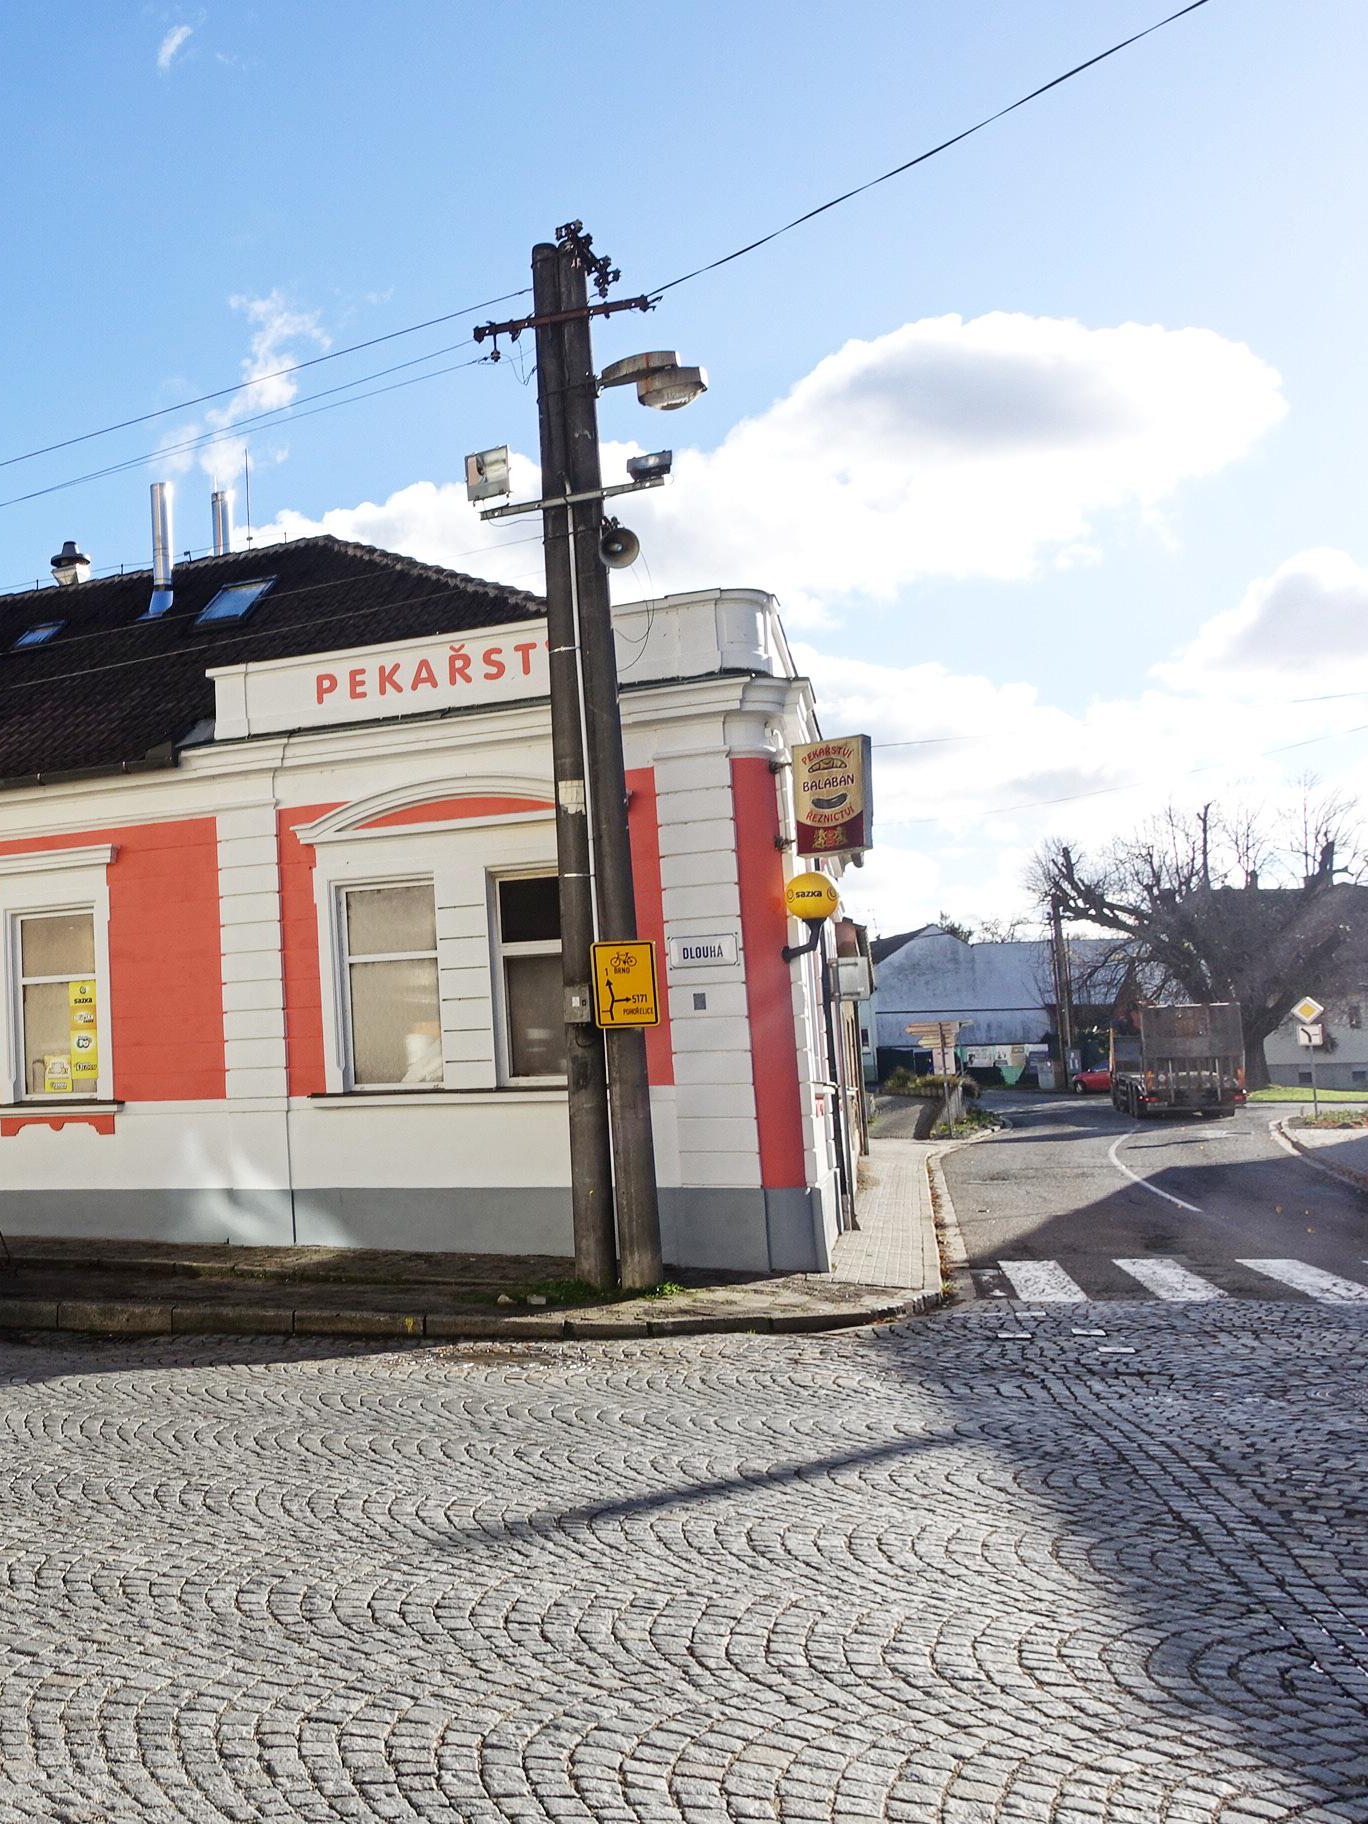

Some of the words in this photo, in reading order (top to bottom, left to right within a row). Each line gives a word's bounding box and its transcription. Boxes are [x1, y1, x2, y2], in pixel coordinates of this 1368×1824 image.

[315, 641, 549, 705] PEKAŘST
[802, 772, 855, 793] BALABÁN
[682, 943, 724, 960] DLOUHÁ
[631, 993, 648, 1004] 5171
